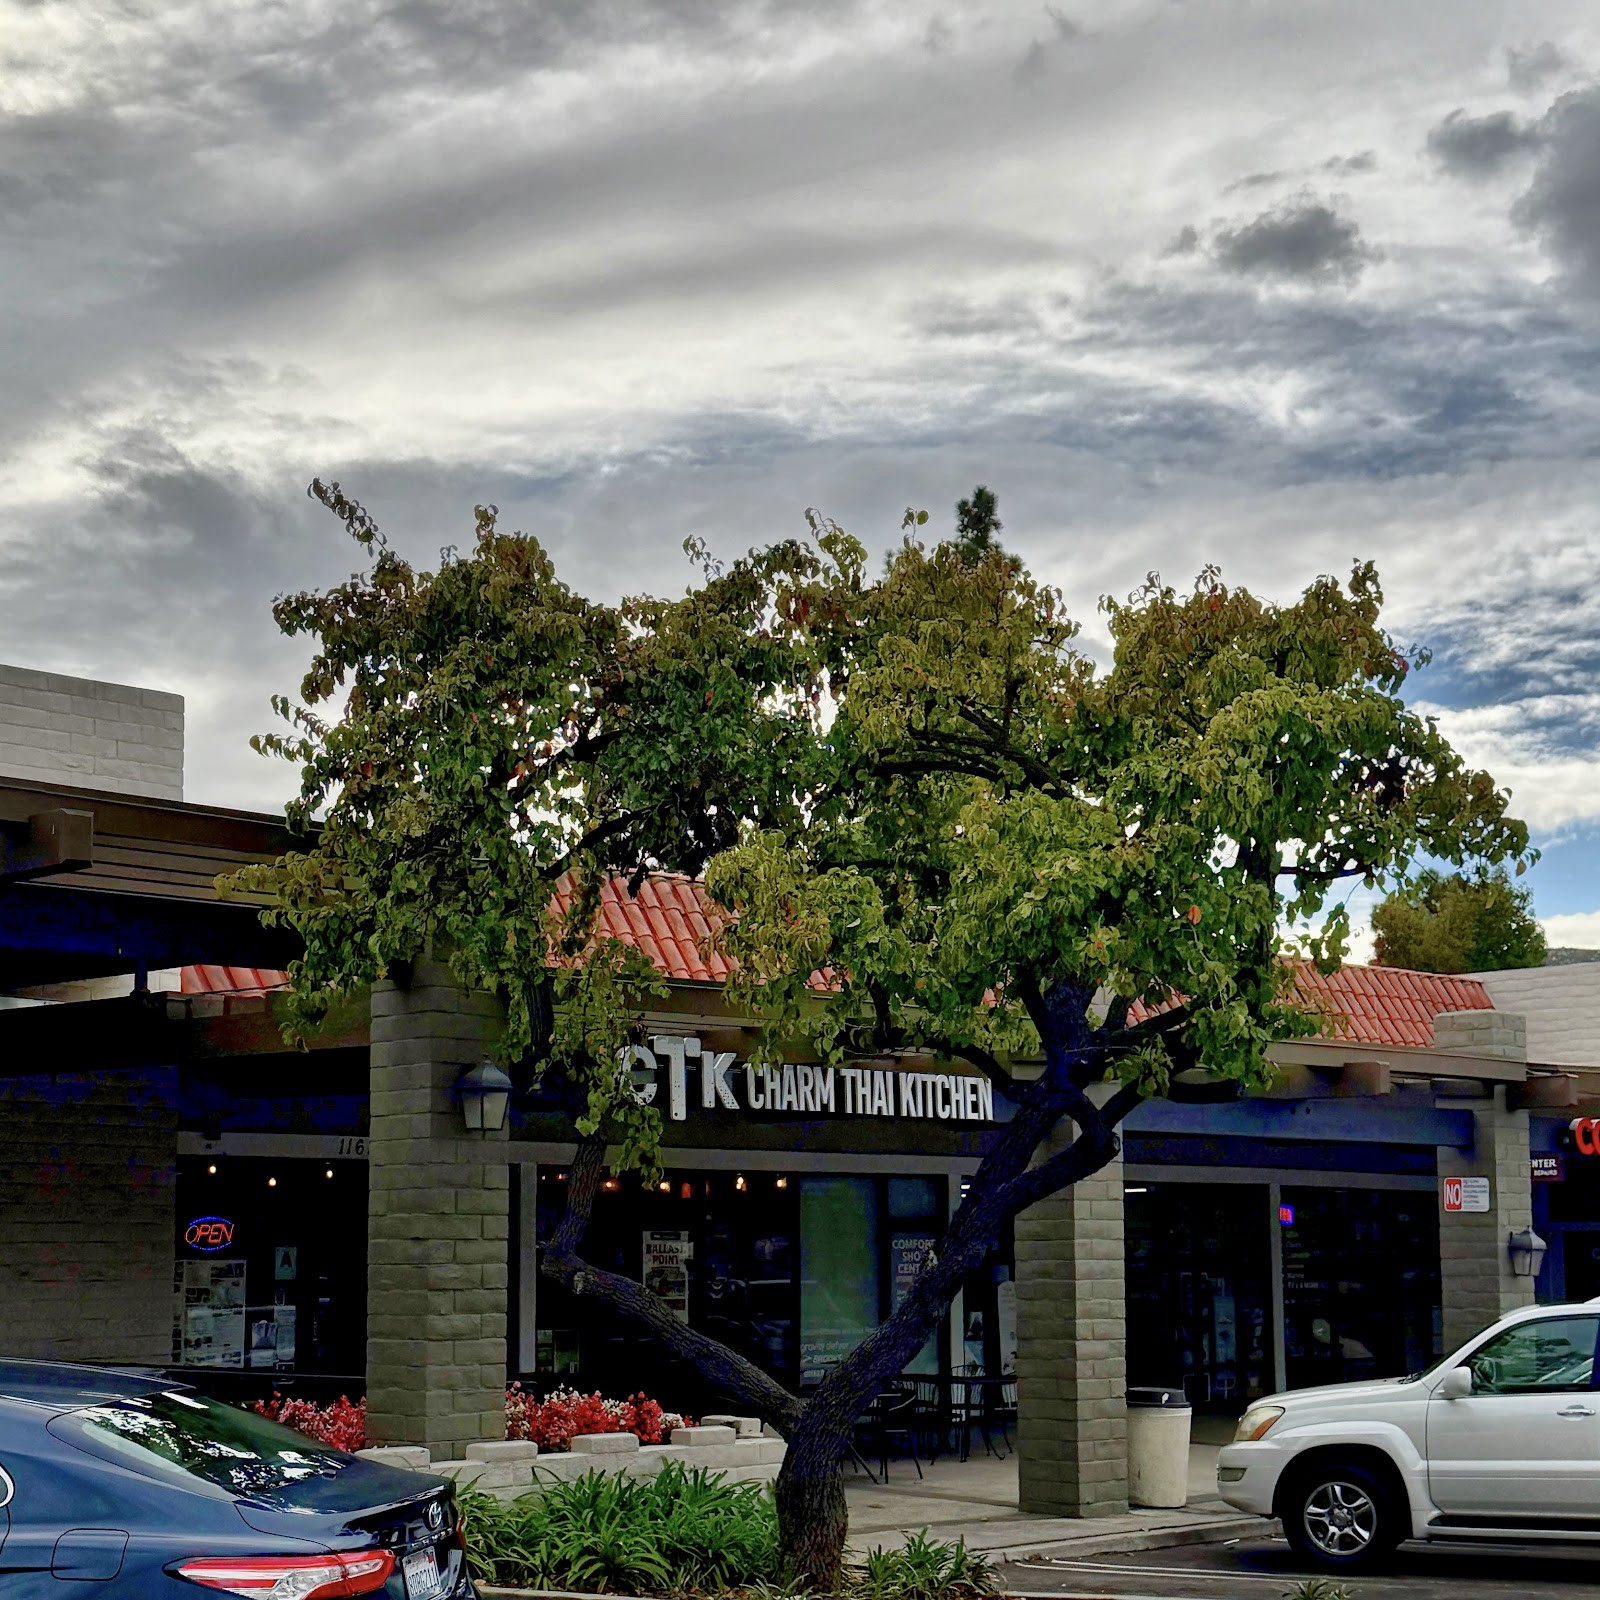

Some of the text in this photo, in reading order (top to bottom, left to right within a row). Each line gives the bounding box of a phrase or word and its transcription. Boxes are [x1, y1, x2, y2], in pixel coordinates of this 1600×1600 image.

[745, 1062, 836, 1113] CHARM
[840, 1068, 895, 1116] THAI
[900, 1072, 994, 1121] KITCHEN
[338, 1138, 369, 1156] 116
[1446, 1184, 1461, 1206] NO
[184, 1223, 235, 1244] OPEN
[280, 1251, 293, 1269] A
[652, 1254, 680, 1265] POINT
[902, 1251, 921, 1262] SHO
[897, 1263, 921, 1274] CENT
